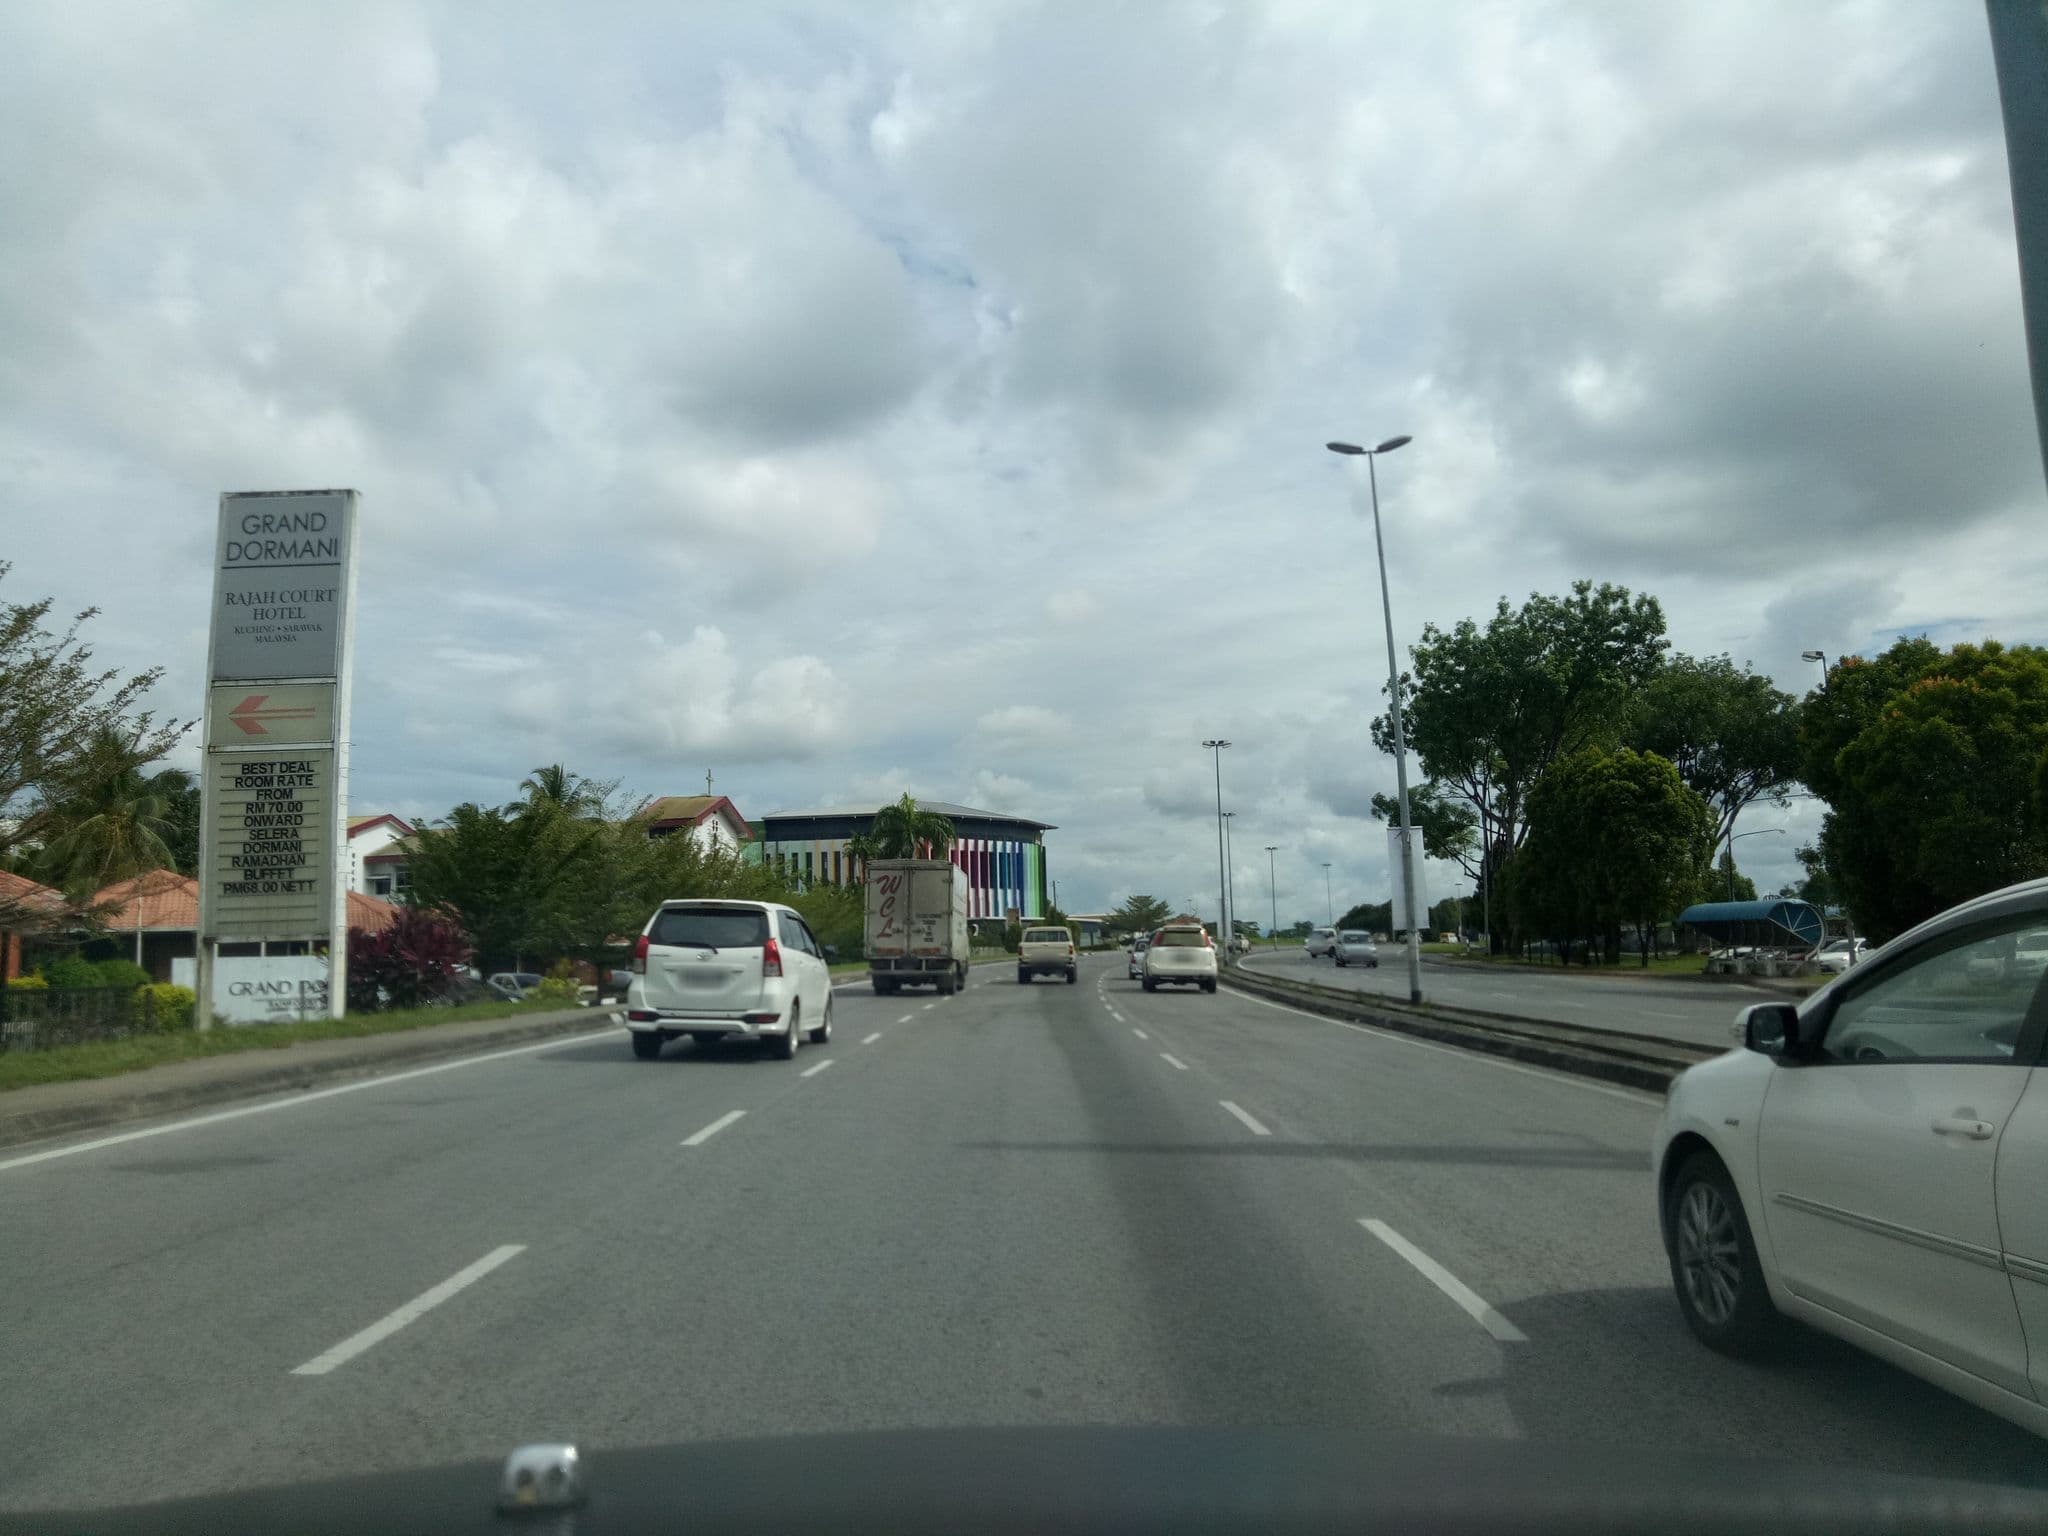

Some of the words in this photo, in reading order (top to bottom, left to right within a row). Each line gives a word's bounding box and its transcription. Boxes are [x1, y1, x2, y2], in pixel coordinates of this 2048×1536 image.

[241, 512, 327, 535] GRAND
[226, 537, 339, 561] DORMANI
[225, 591, 275, 606] RAJAH
[279, 589, 336, 604] COURT
[253, 606, 306, 621] HOTEL
[233, 625, 275, 635] KUCHING
[283, 623, 323, 633] SARAWAK
[255, 634, 297, 643] MALAYSIA
[241, 763, 276, 775] BEST
[279, 761, 315, 774] DEAL
[234, 776, 274, 788] ROOM
[277, 775, 314, 786] RATE
[256, 789, 293, 800] FROM
[246, 802, 265, 814] RM
[268, 801, 303, 813] 70.00
[244, 815, 304, 827] ONWARD
[249, 828, 299, 840] SELERA
[242, 841, 302, 854] DORMANI
[231, 854, 306, 868] RAMADHAN
[281, 880, 314, 892] NETT
[228, 981, 292, 996] GRAND
